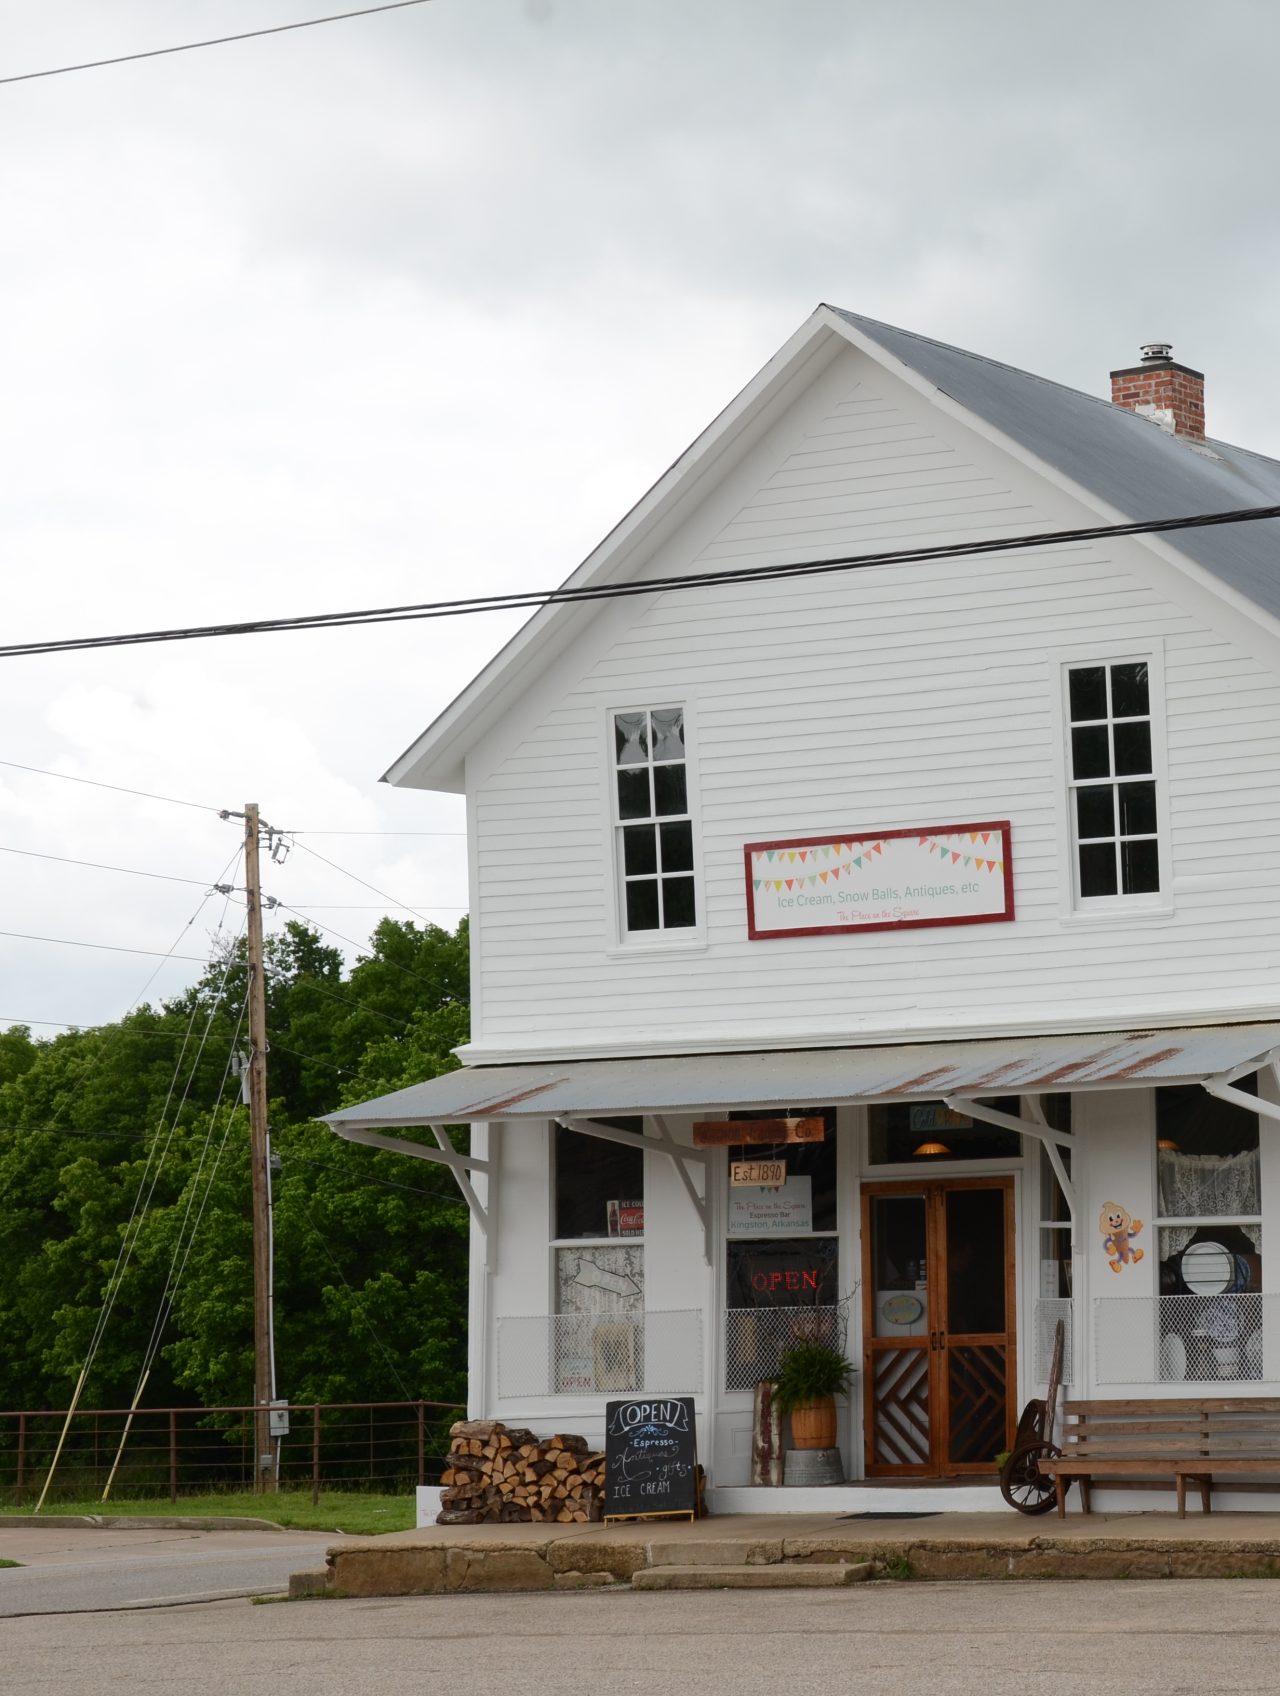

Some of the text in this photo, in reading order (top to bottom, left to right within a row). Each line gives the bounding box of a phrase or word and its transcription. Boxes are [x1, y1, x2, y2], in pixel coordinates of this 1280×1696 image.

[778, 882, 980, 908] Ice Cream, Snow Balls, Antiques, etc
[837, 911, 849, 921] The
[851, 910, 870, 921] Place
[881, 909, 891, 919] the
[893, 906, 920, 922] Square
[731, 1219, 810, 1230] Kingston, Arkansas
[751, 1270, 818, 1292] OPEN
[626, 1402, 671, 1424] OPEN
[613, 1481, 670, 1498] ICE CREAM
